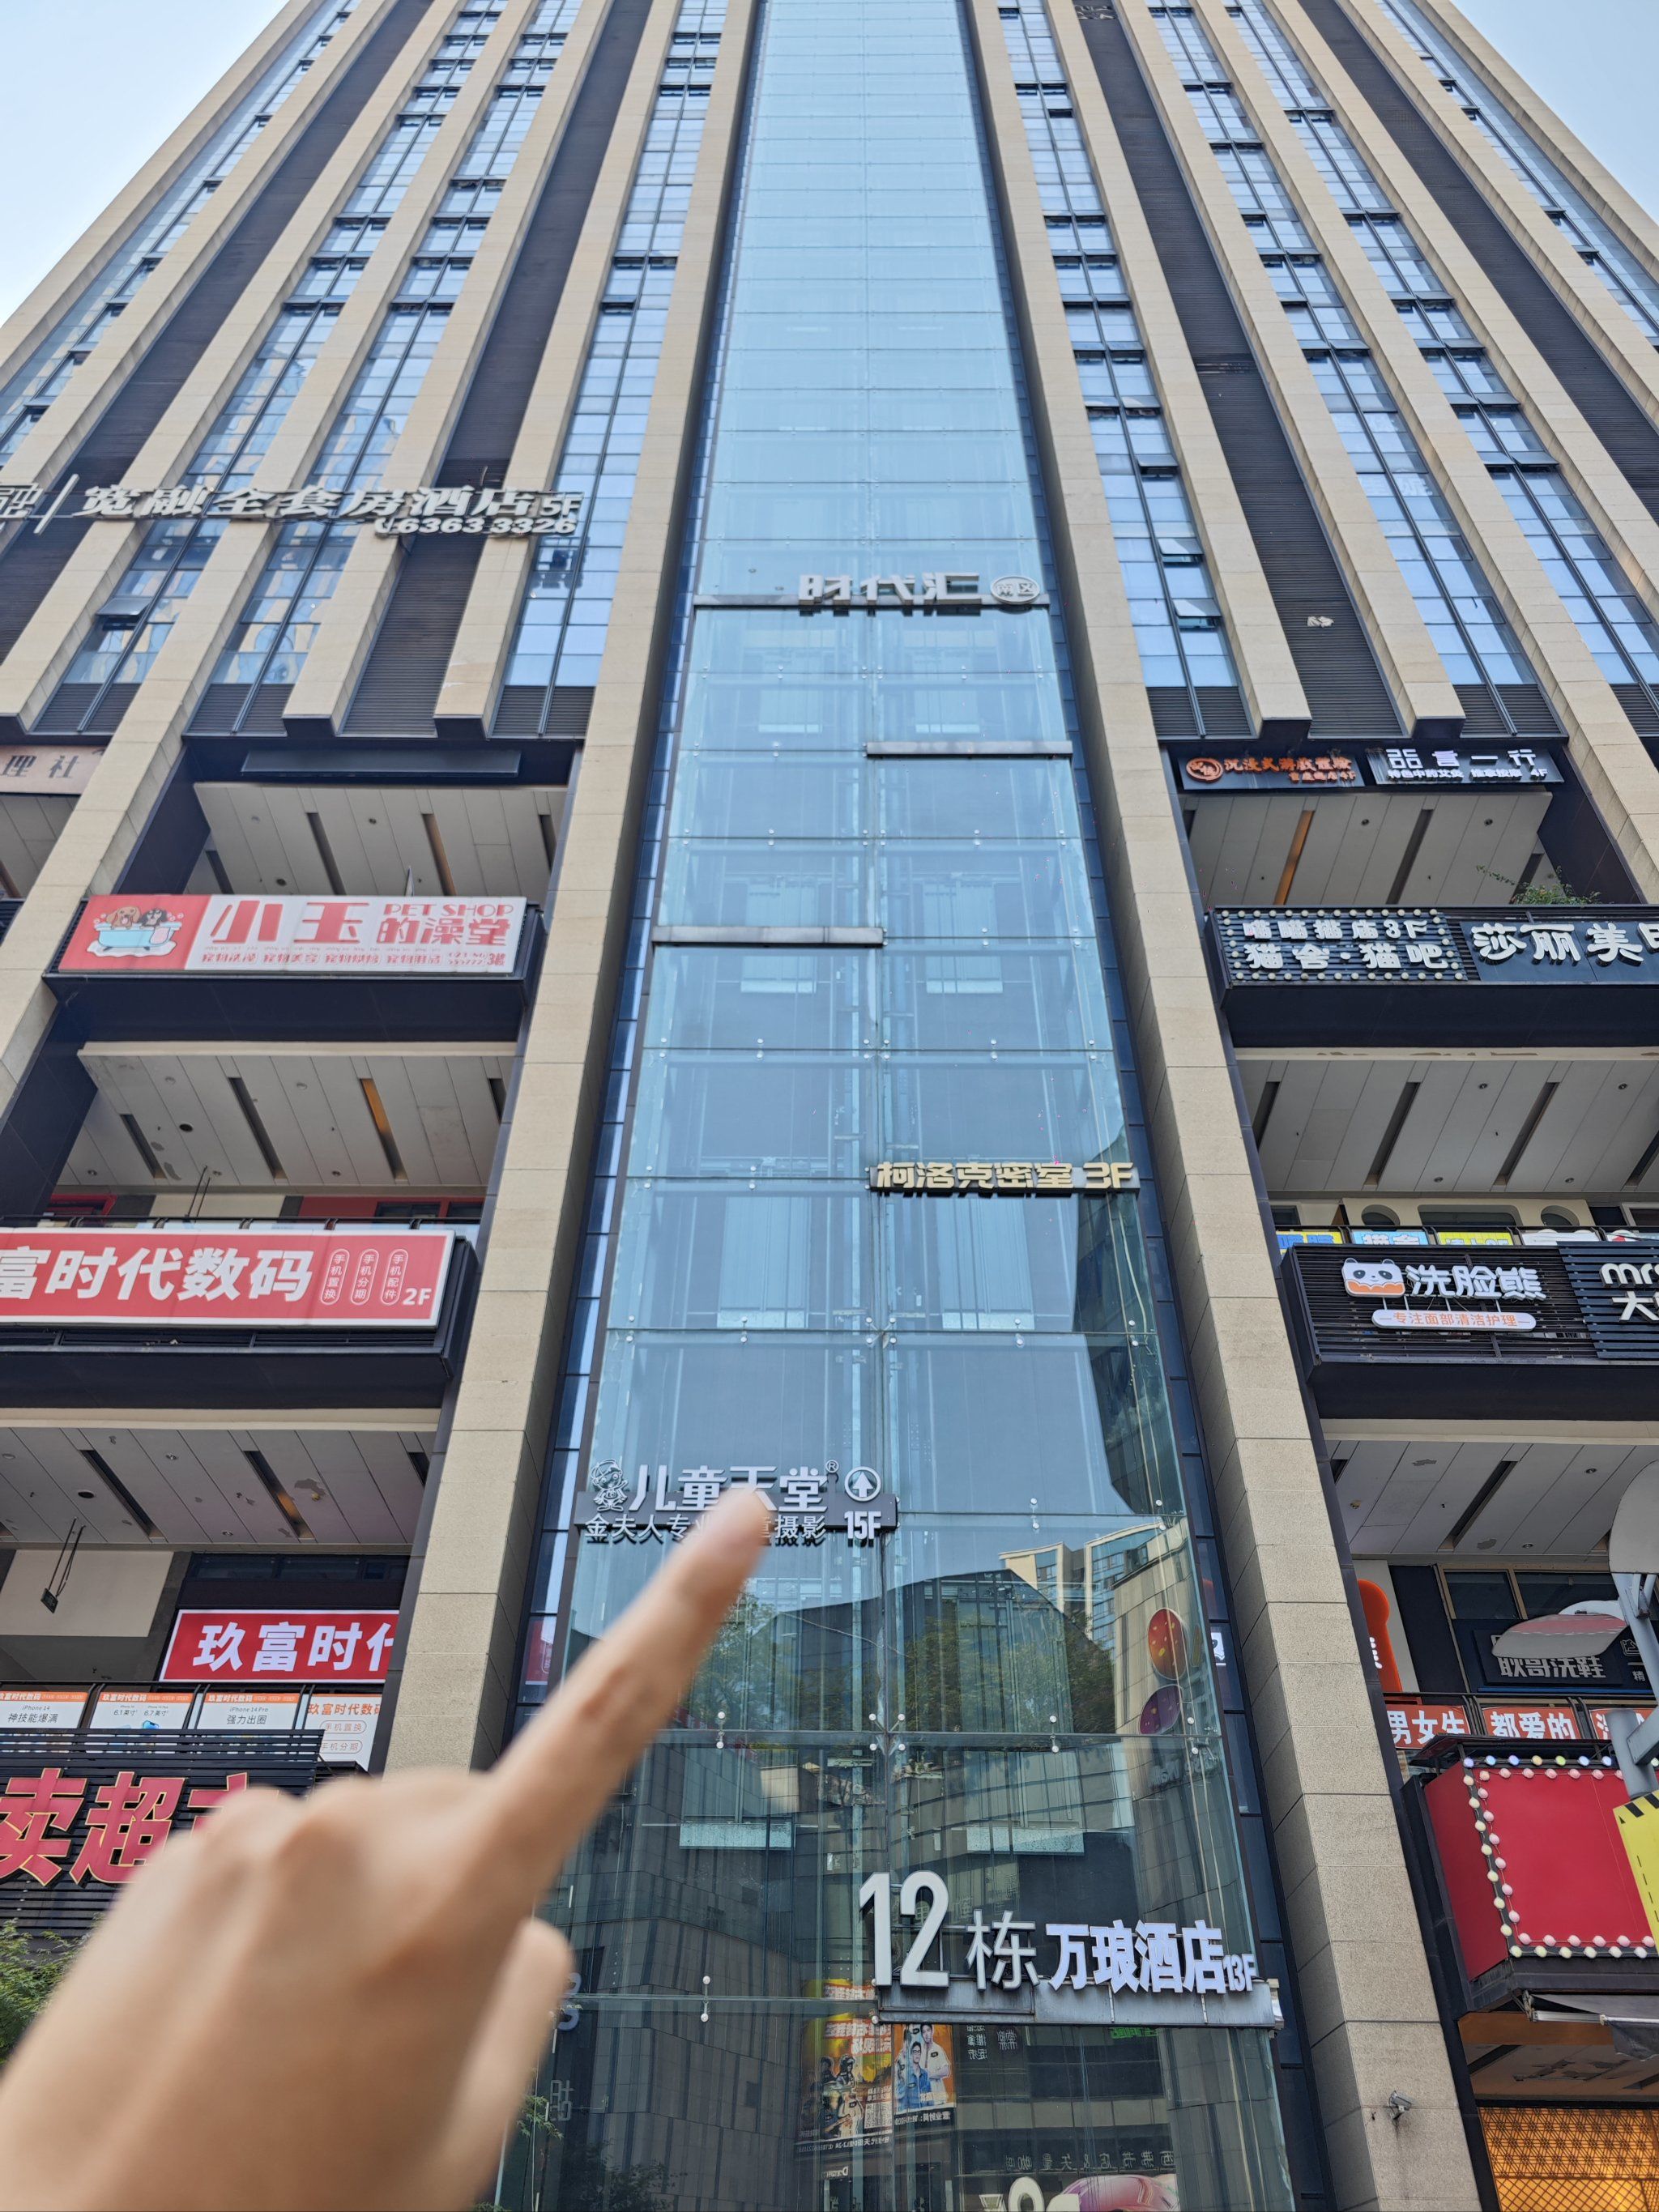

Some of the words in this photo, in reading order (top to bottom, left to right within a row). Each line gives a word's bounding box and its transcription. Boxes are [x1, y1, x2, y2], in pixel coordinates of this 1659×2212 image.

[800, 573, 981, 601] 时代汇
[211, 900, 370, 944] 小玉
[383, 903, 437, 916] PET
[441, 903, 514, 917] SHOP
[377, 917, 511, 946] 的澡堂
[877, 1161, 1073, 1189] 柯洛克密室
[1083, 1162, 1133, 1189] 3F
[403, 1288, 432, 1306] 2F
[1405, 1264, 1546, 1301] 洗脸熊
[1392, 1311, 1518, 1327] 专注面部清洁护理
[629, 1464, 828, 1513] 儿童天堂
[844, 1511, 882, 1540] 15F
[0, 1767, 279, 1886] 卖超
